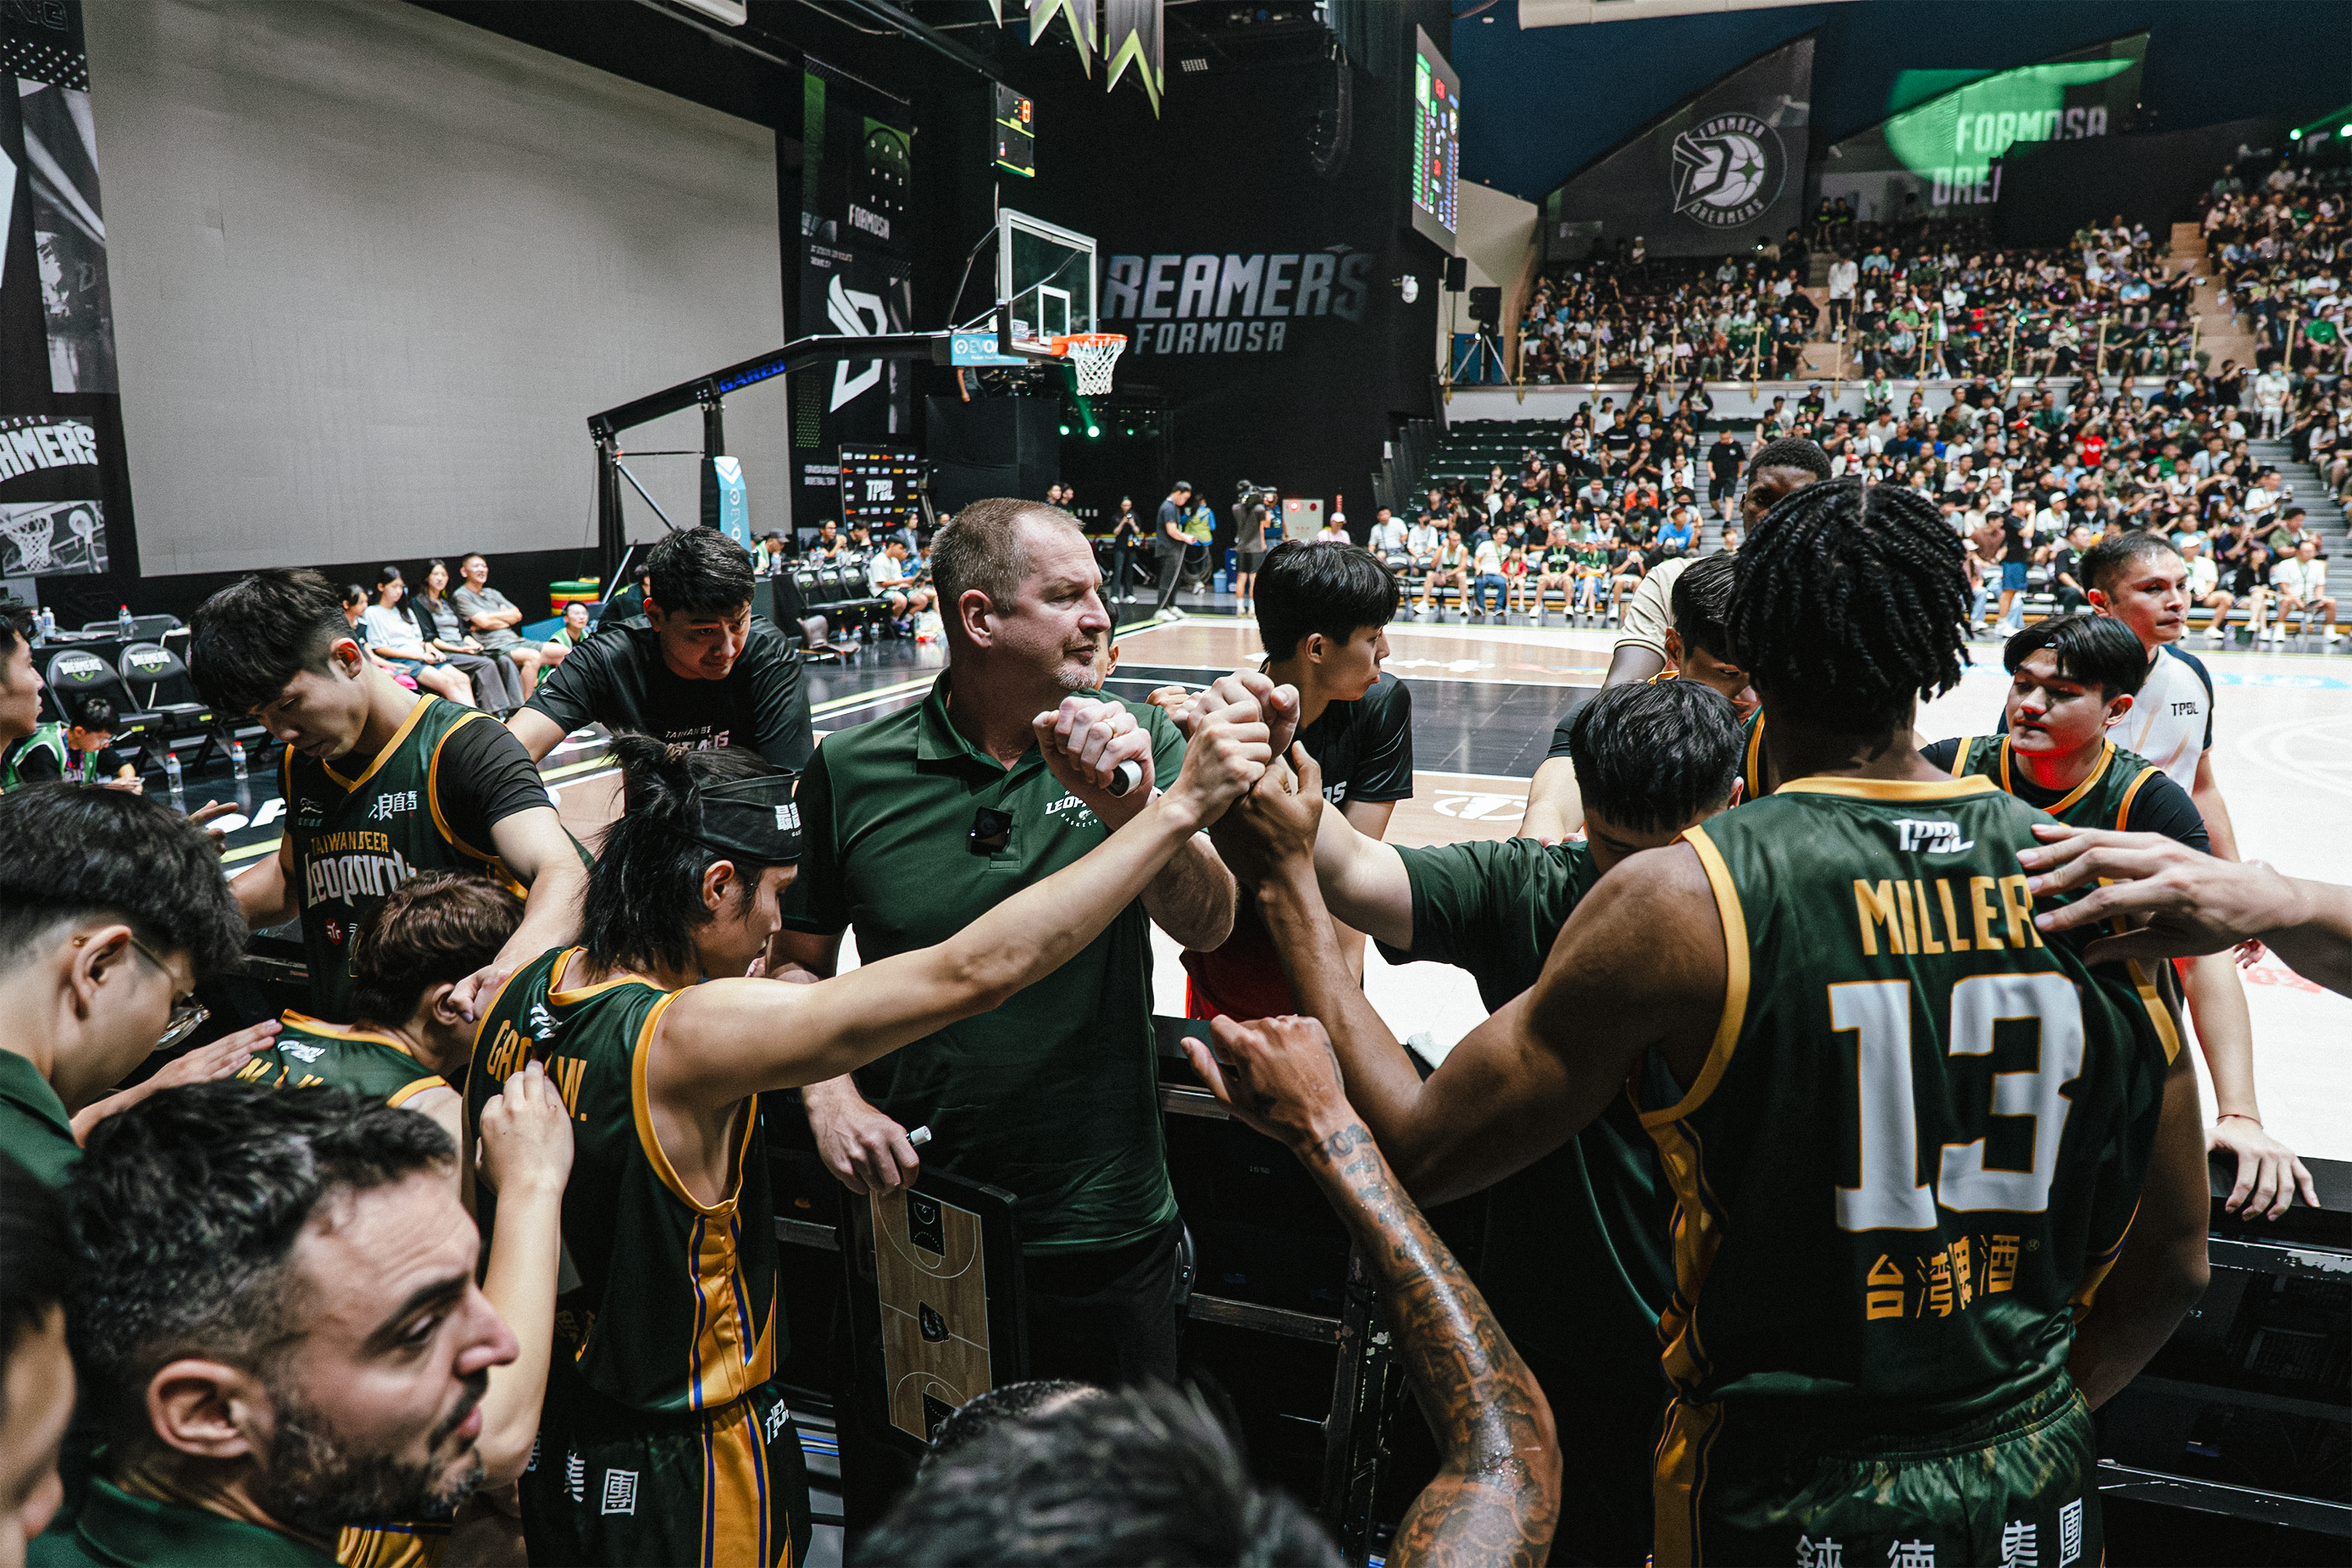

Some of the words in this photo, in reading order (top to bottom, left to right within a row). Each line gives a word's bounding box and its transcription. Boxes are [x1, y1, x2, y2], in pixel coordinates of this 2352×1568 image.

[1955, 105, 2108, 156] FORMOSA
[1933, 166, 2001, 206] DRE
[1101, 253, 1374, 324] REAMERS
[1134, 320, 1286, 356] FORMOSA
[720, 359, 785, 392] GARED
[0, 424, 98, 483] AMERS
[2171, 701, 2199, 717] TPBL
[1892, 817, 1975, 854] TPBL
[1853, 875, 2044, 956] MILLER
[1827, 972, 2086, 1232] 13
